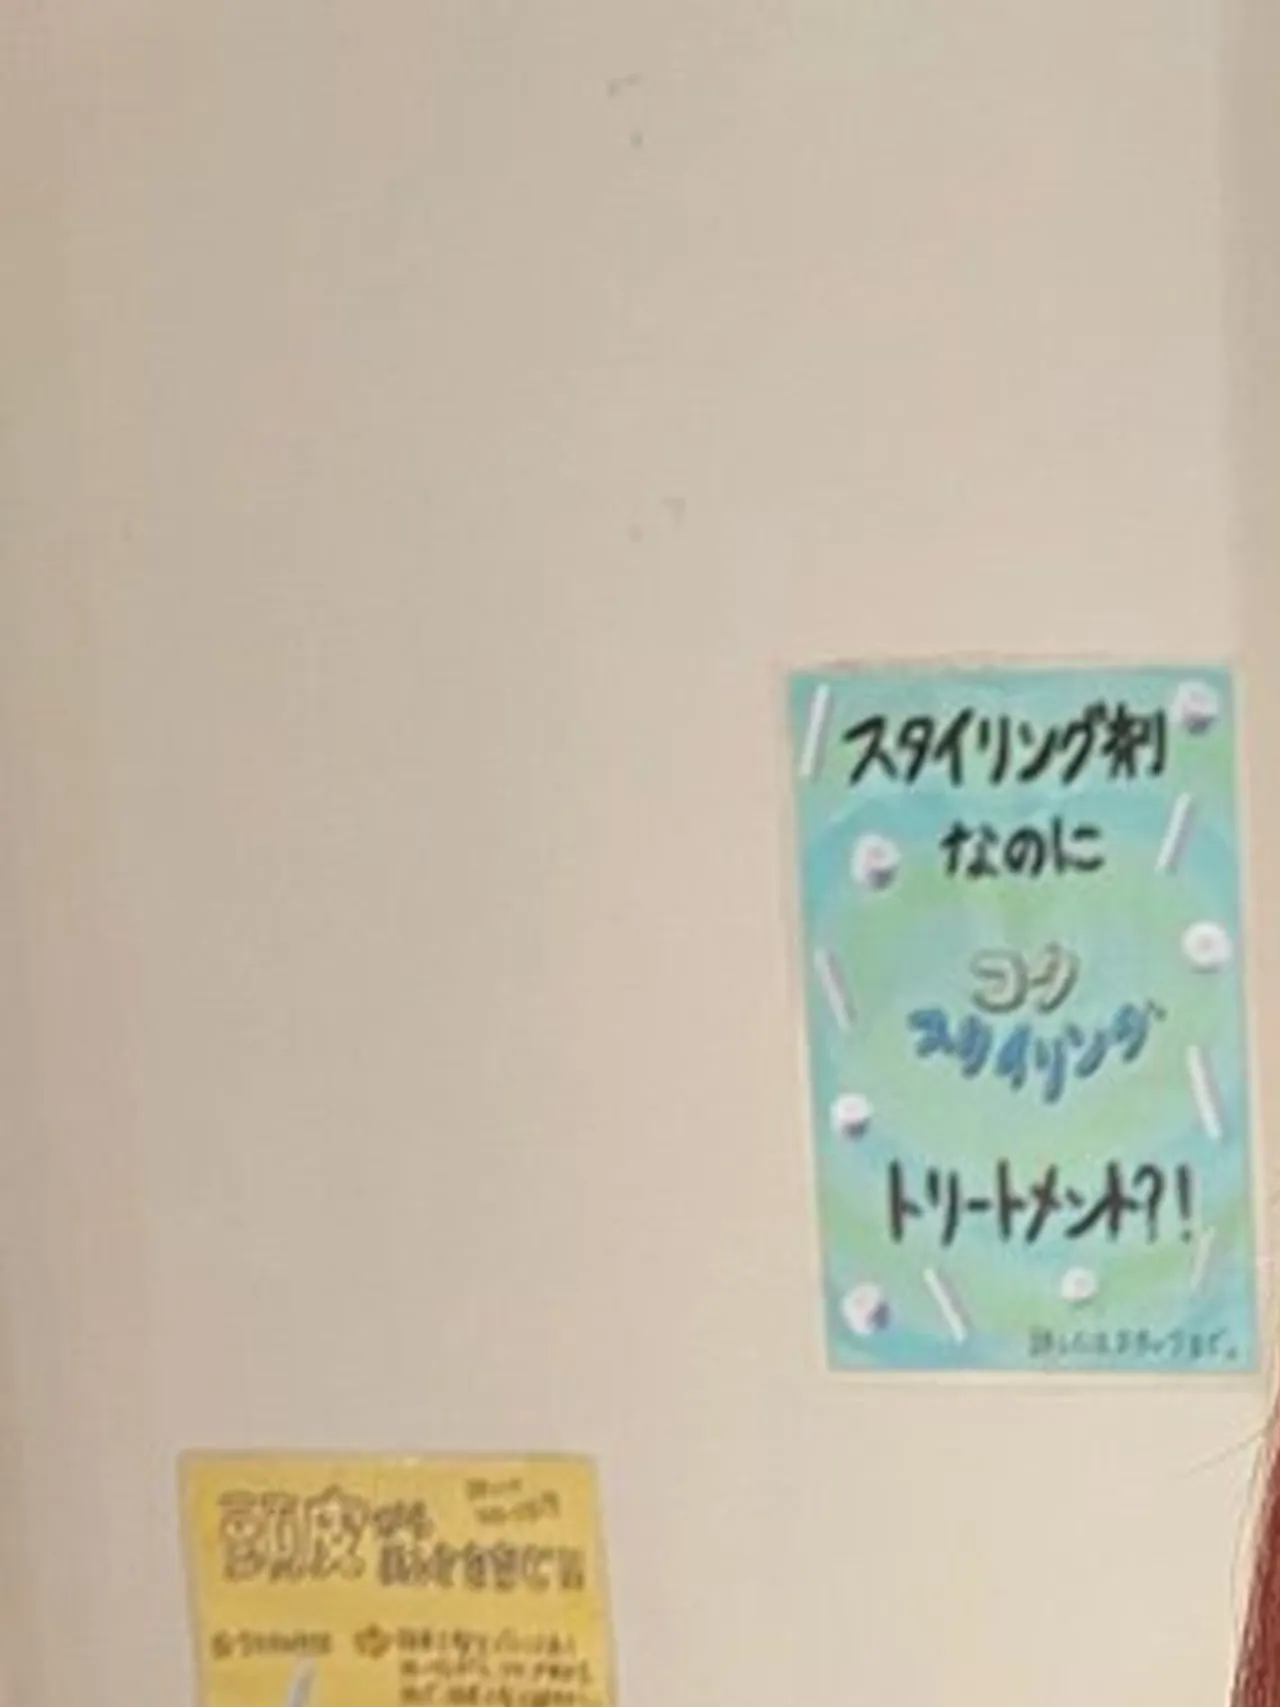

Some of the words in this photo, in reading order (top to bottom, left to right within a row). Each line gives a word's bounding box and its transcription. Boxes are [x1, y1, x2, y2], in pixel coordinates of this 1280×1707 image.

[842, 698, 1168, 787] スタイリング剤
[939, 818, 1105, 879] なのに
